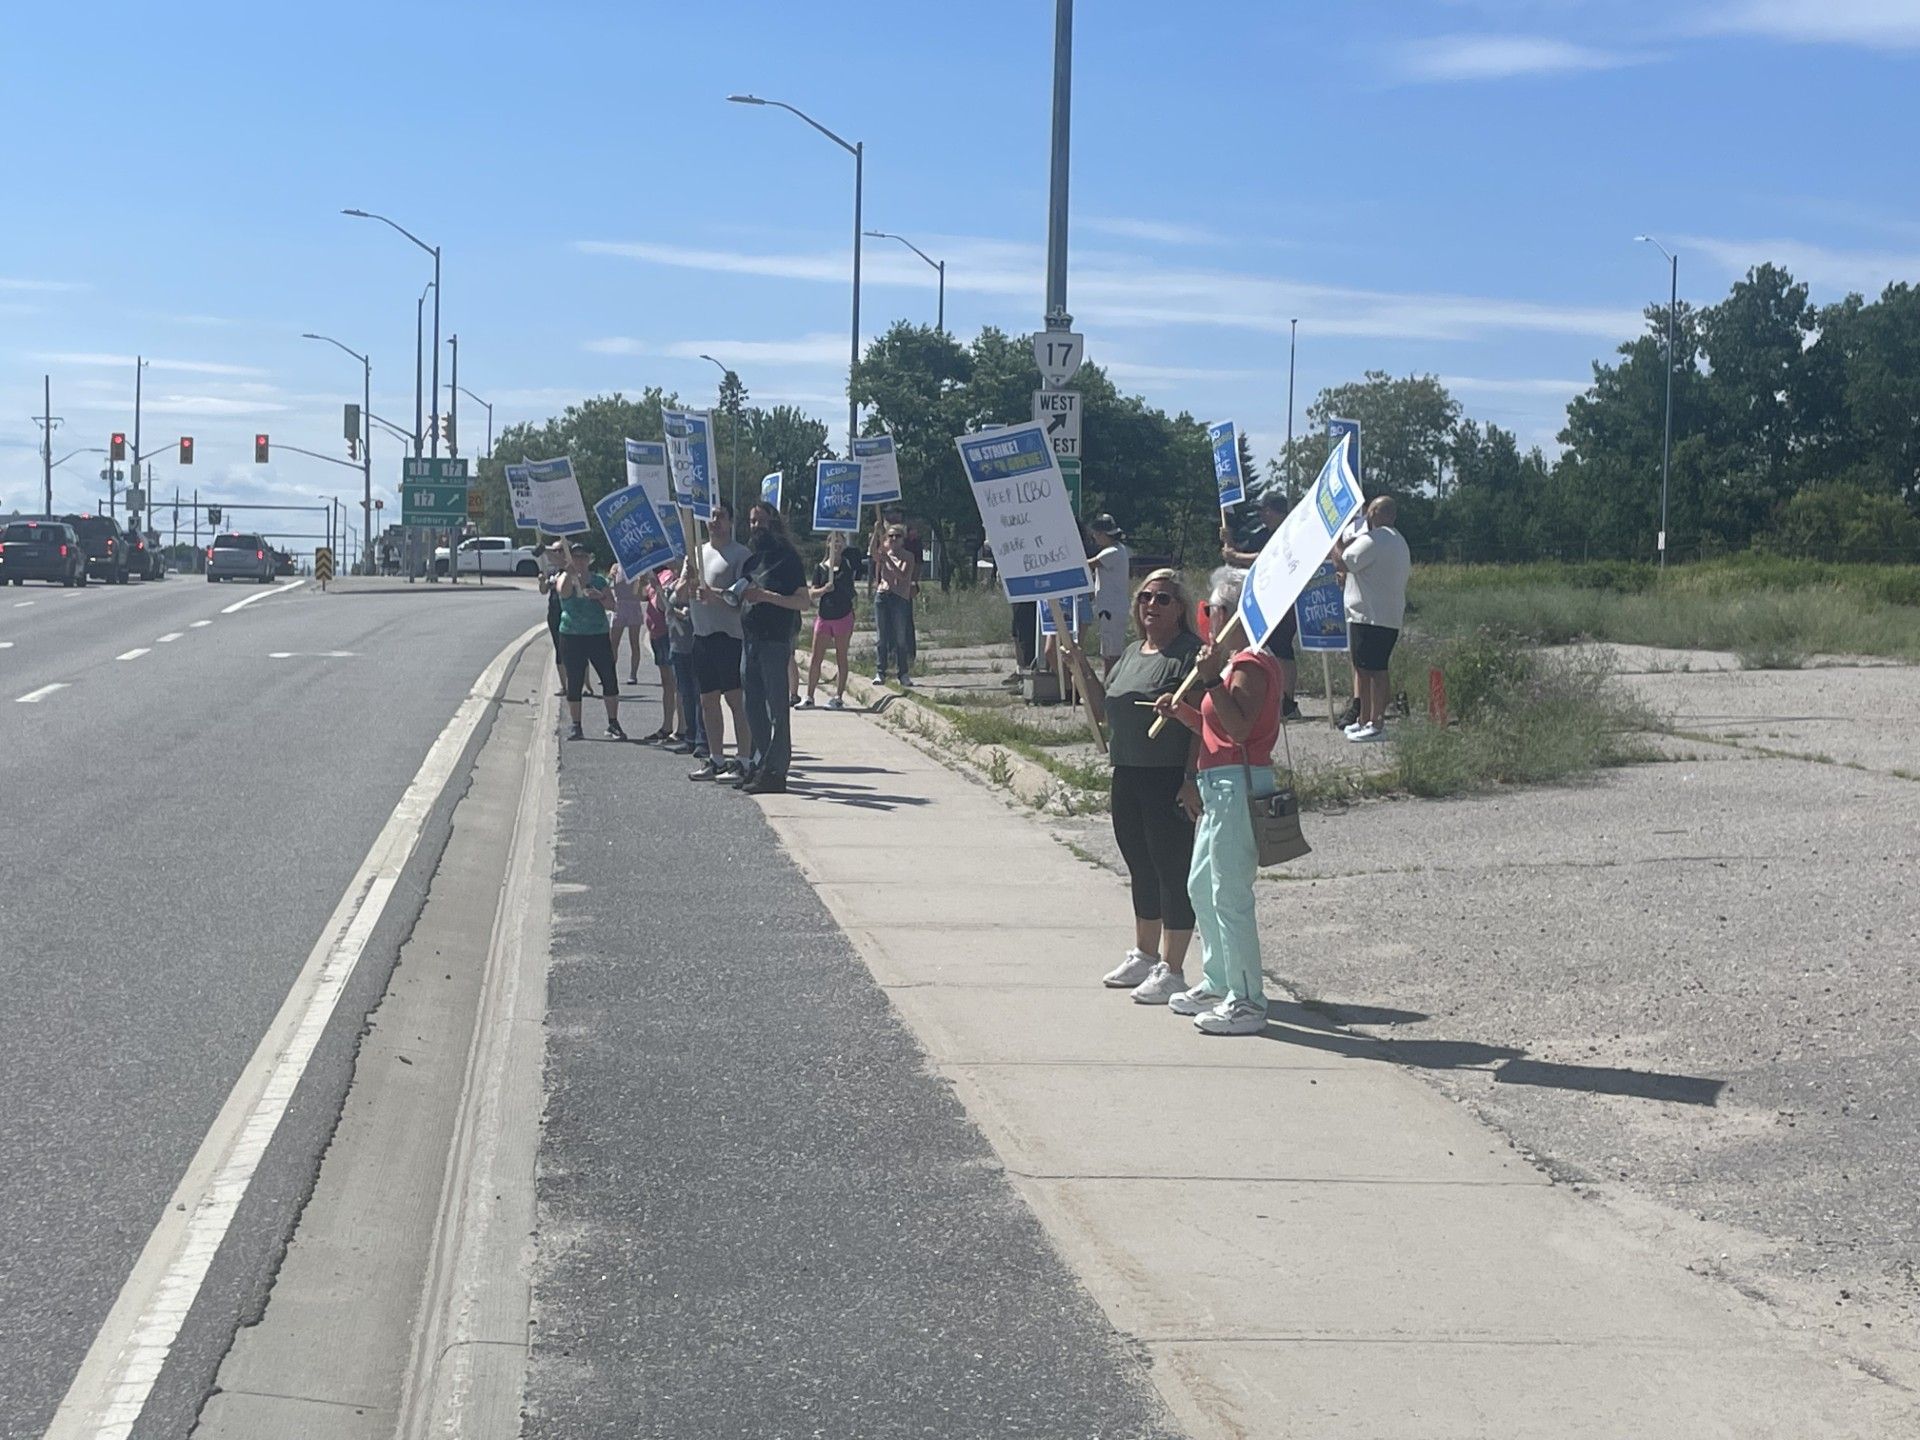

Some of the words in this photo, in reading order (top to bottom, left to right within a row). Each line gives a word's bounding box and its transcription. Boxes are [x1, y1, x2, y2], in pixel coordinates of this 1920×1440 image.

[1046, 342, 1073, 367] 17
[1040, 394, 1075, 411] WEST
[1050, 438, 1077, 454] EST
[831, 484, 844, 494] ON
[985, 488, 1011, 507] KEEP
[1016, 479, 1051, 504] LCBO
[606, 495, 629, 518] LCBO
[823, 494, 853, 509] STRIKE
[620, 514, 637, 532] ON
[620, 520, 653, 550] STRIKE
[1034, 535, 1044, 548] IT
[1311, 587, 1326, 604] ON
[1304, 601, 1338, 622] STRIKE
